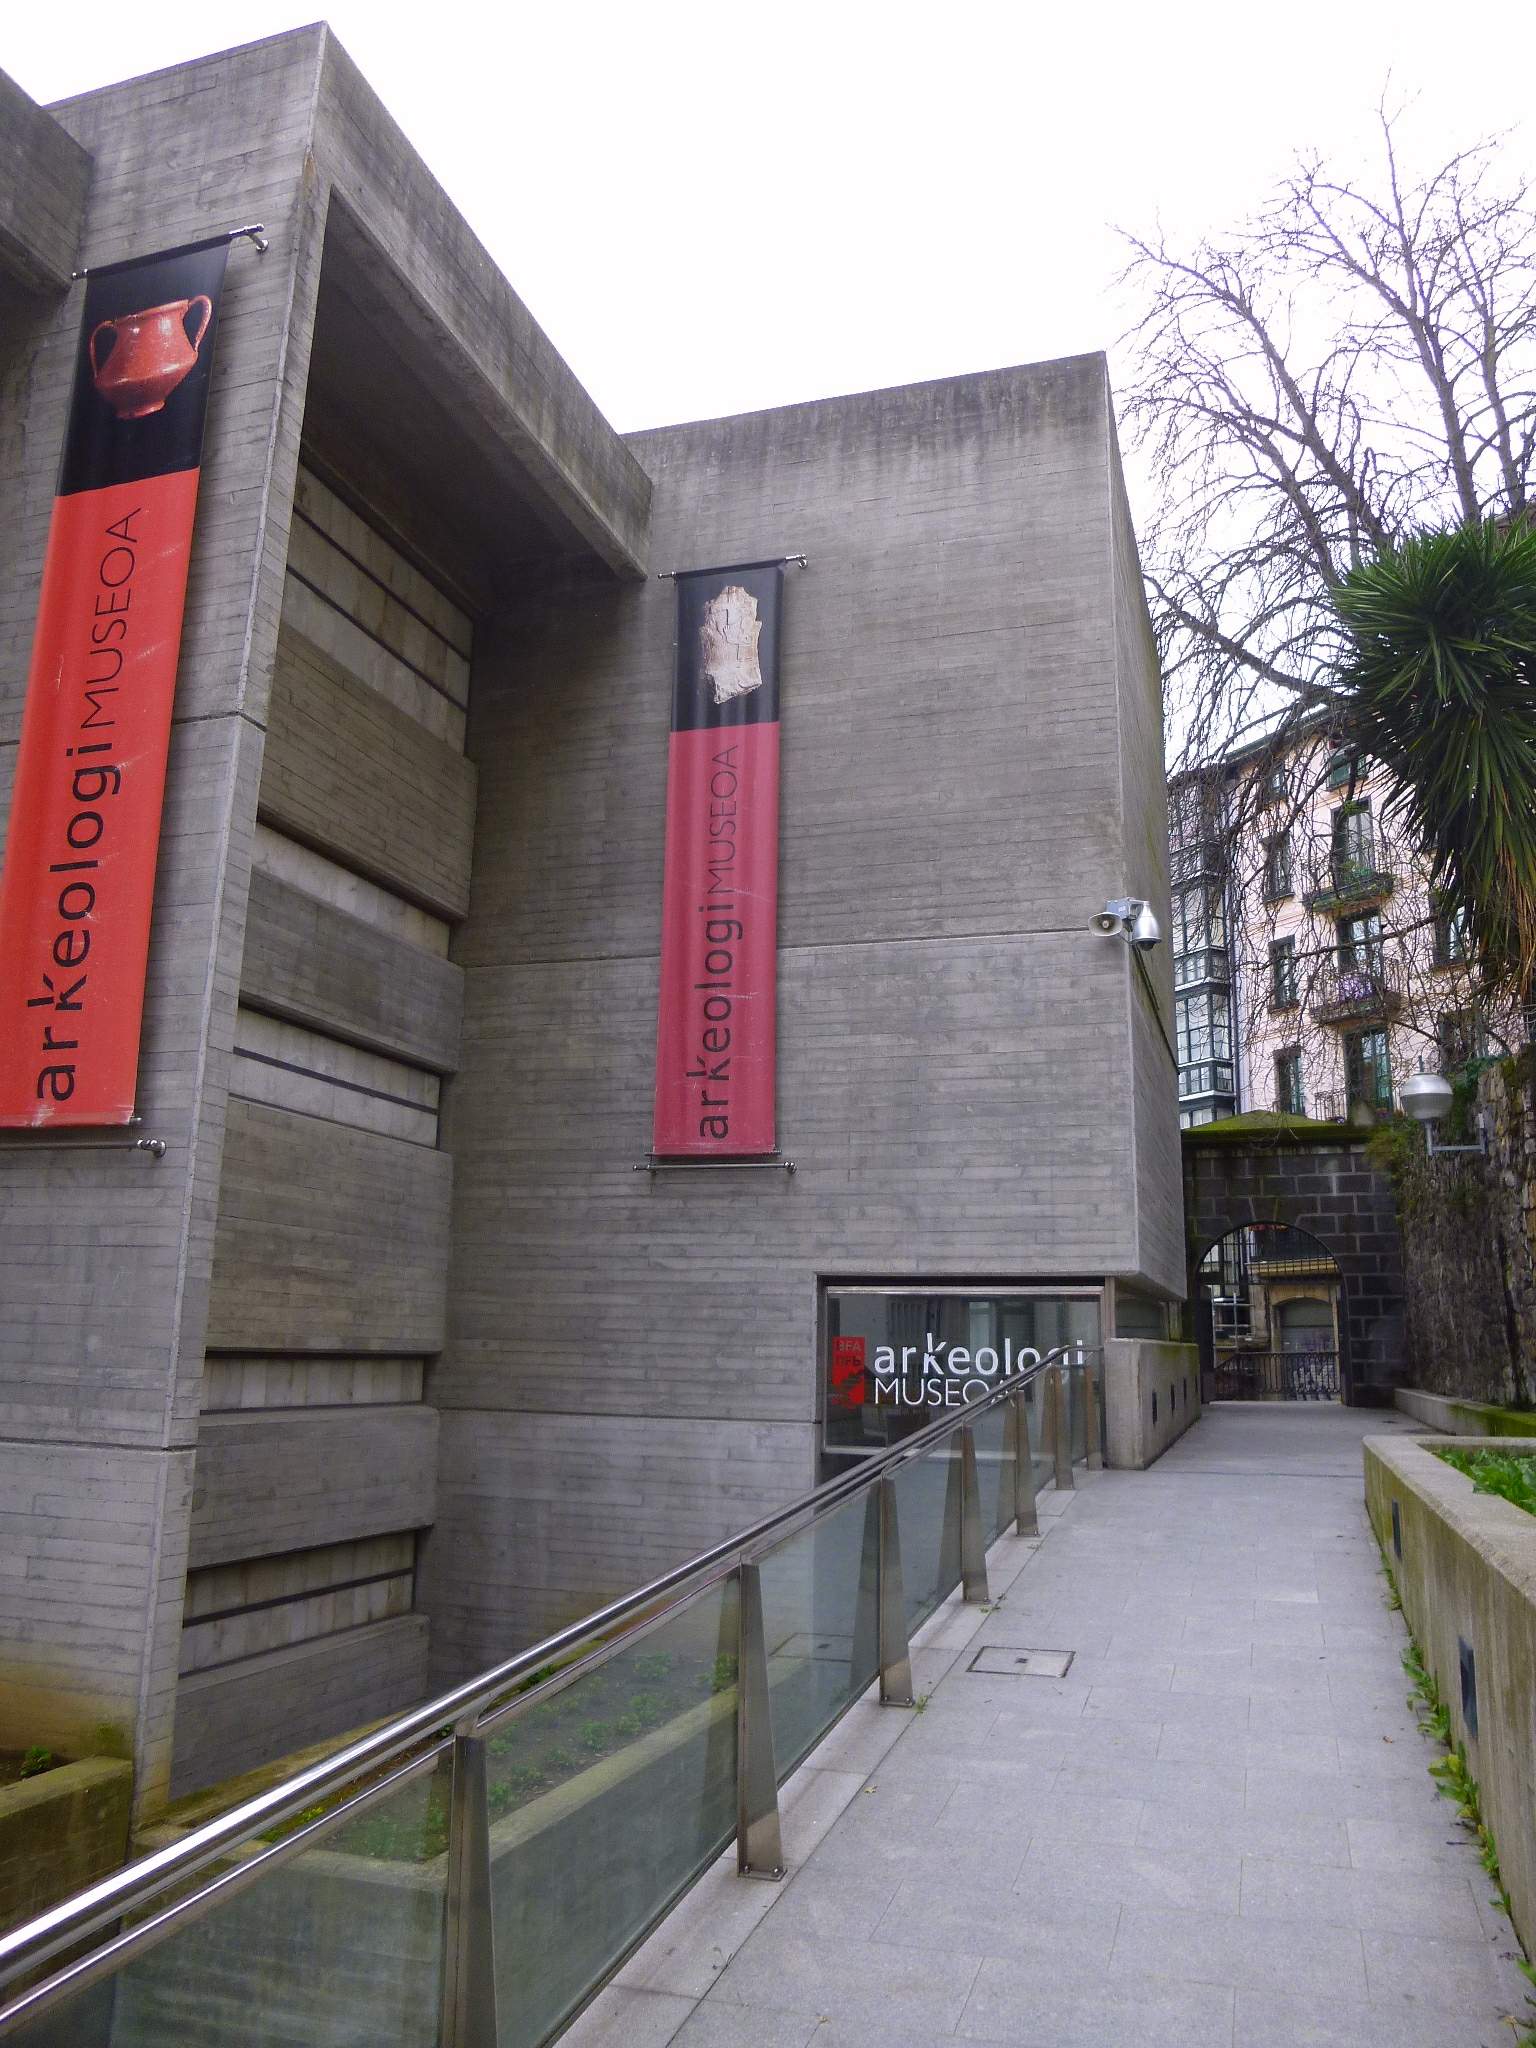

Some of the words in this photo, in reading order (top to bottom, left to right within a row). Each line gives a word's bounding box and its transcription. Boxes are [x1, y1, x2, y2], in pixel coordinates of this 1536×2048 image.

[27, 743, 121, 1101] arkeologi
[80, 507, 142, 729] MUSEOA
[707, 745, 738, 894] MUSEOA
[686, 904, 743, 1139] arkeologi
